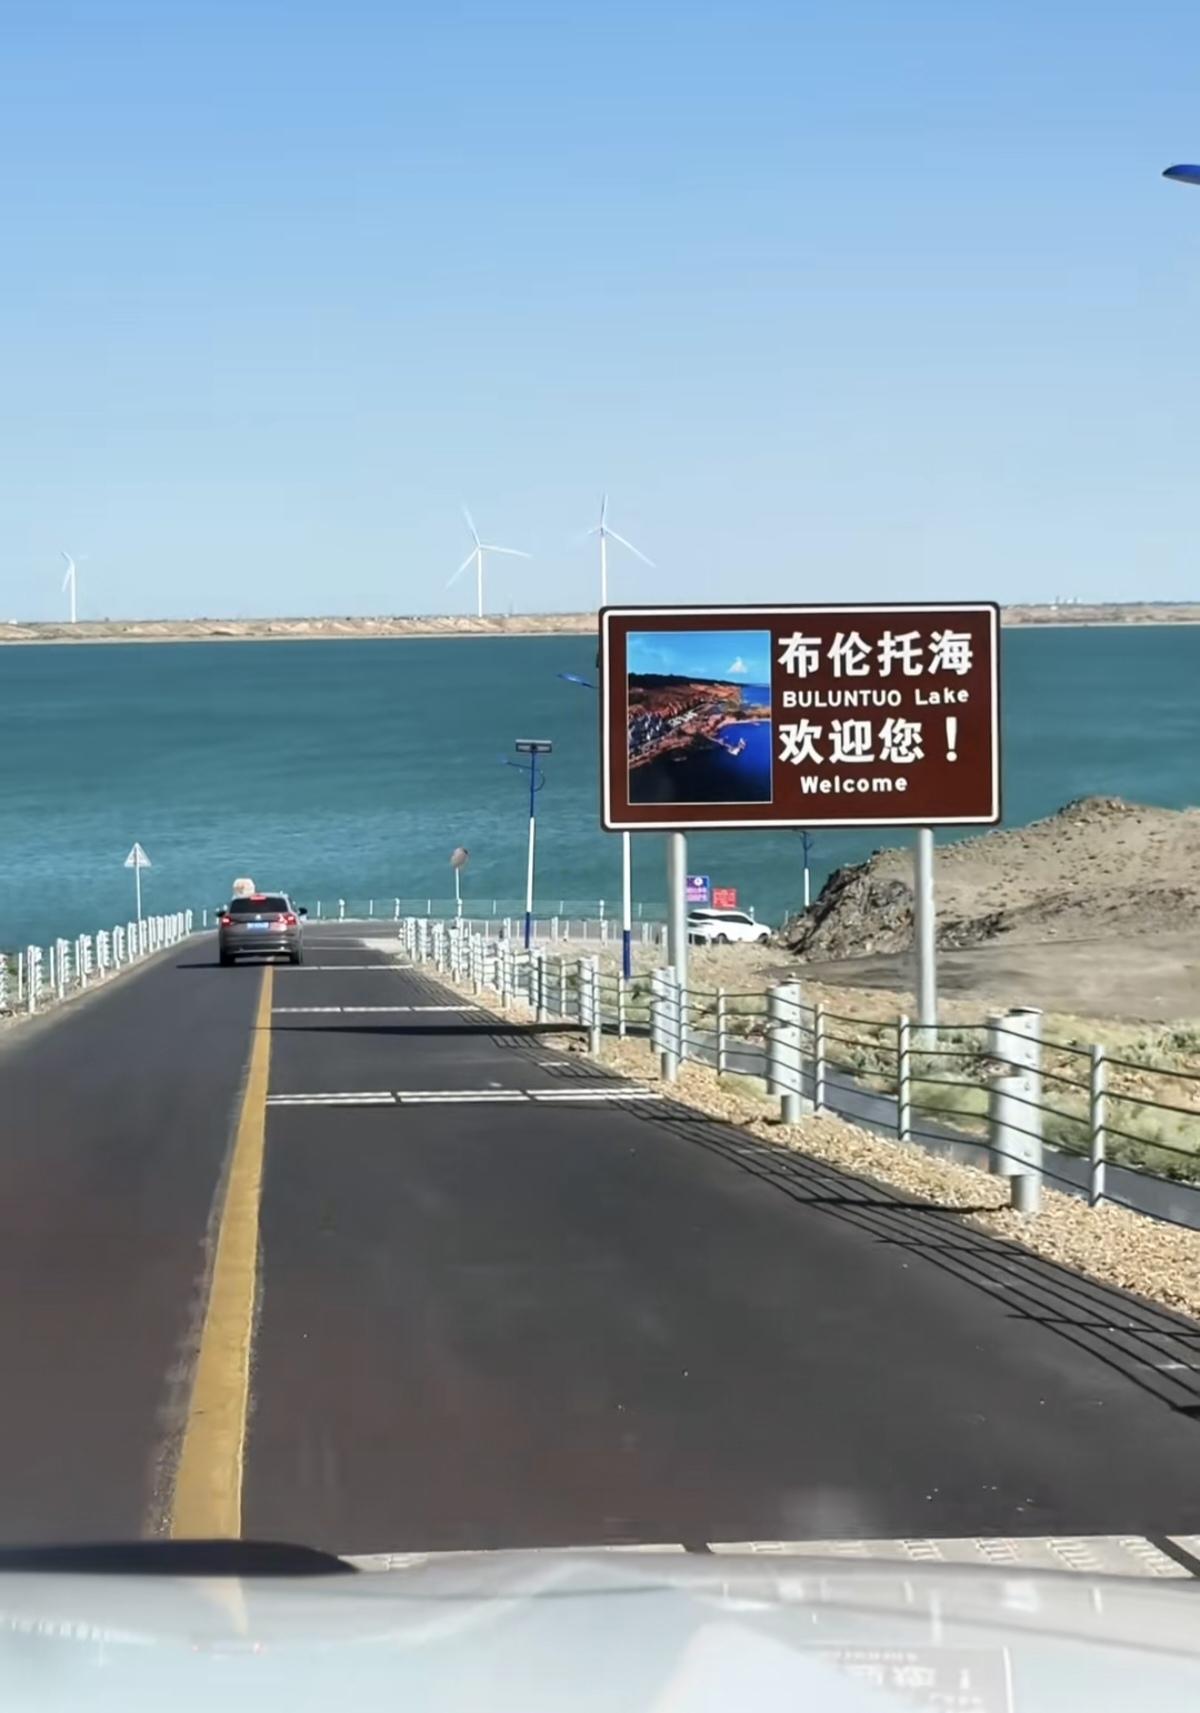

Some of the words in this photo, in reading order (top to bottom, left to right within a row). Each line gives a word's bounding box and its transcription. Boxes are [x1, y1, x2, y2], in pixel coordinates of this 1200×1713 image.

[778, 630, 974, 679] 布伦托海
[782, 689, 902, 708] BULUNTUO
[914, 687, 970, 706] Lake
[800, 775, 908, 794] Welcome
